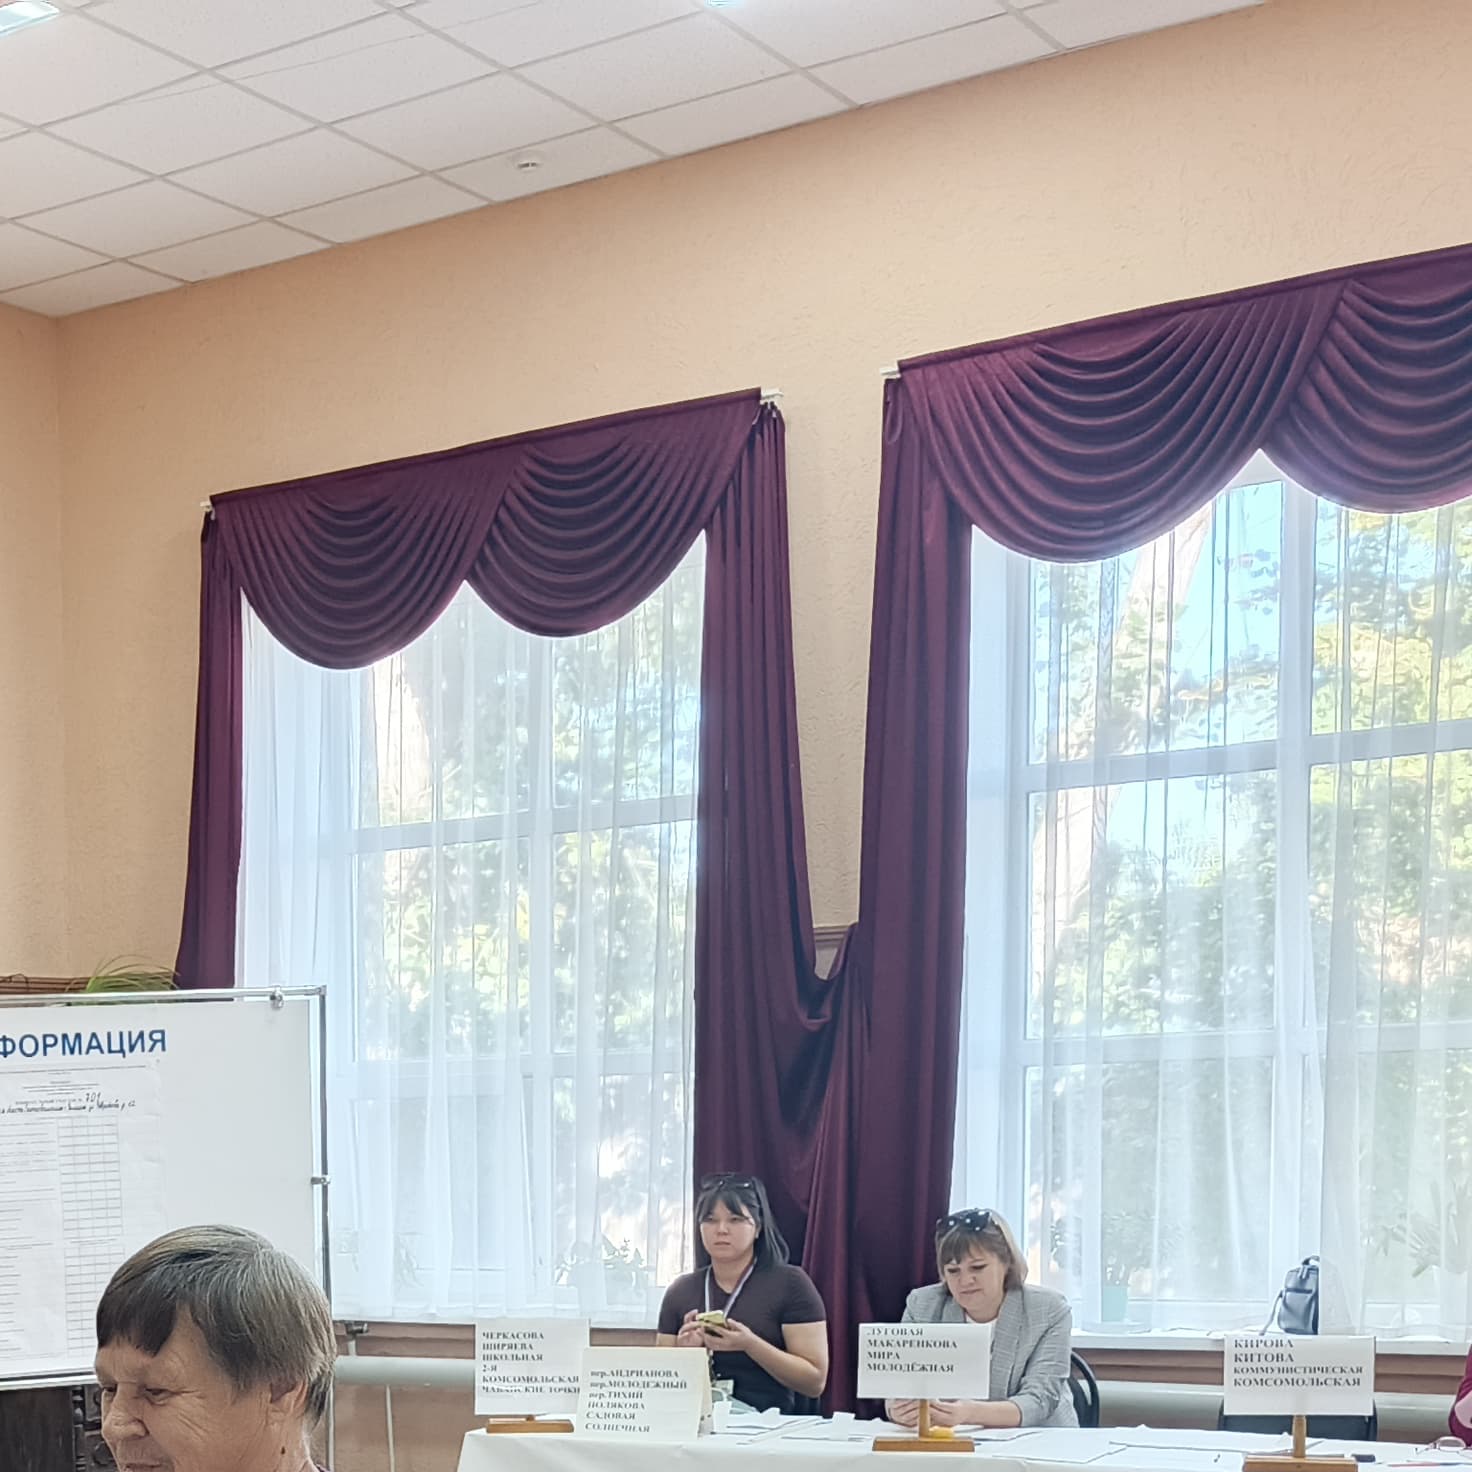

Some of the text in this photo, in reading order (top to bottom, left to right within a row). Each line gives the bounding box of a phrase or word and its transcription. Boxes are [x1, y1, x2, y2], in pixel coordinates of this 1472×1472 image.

[482, 1331, 545, 1341] ЧЕРКАСОВА
[482, 1342, 534, 1351] ШИРЯЕВА
[867, 1339, 958, 1349] МАКАРЕНКОВА
[1234, 1339, 1294, 1348] КИРОВА
[482, 1353, 543, 1362] ШКОЛЬНАЯ
[867, 1351, 900, 1360] МИРА
[867, 1362, 955, 1373] МОЛОДЁЖНАЯ
[1233, 1366, 1364, 1375] КОММУНИСТИЧЕСКАЯ
[1233, 1377, 1361, 1387] КОМСОМОЛЬСКАЯ
[586, 1411, 636, 1420] САДОВАЯ
[585, 1422, 650, 1433] СОЛНЕЧНАЯ
